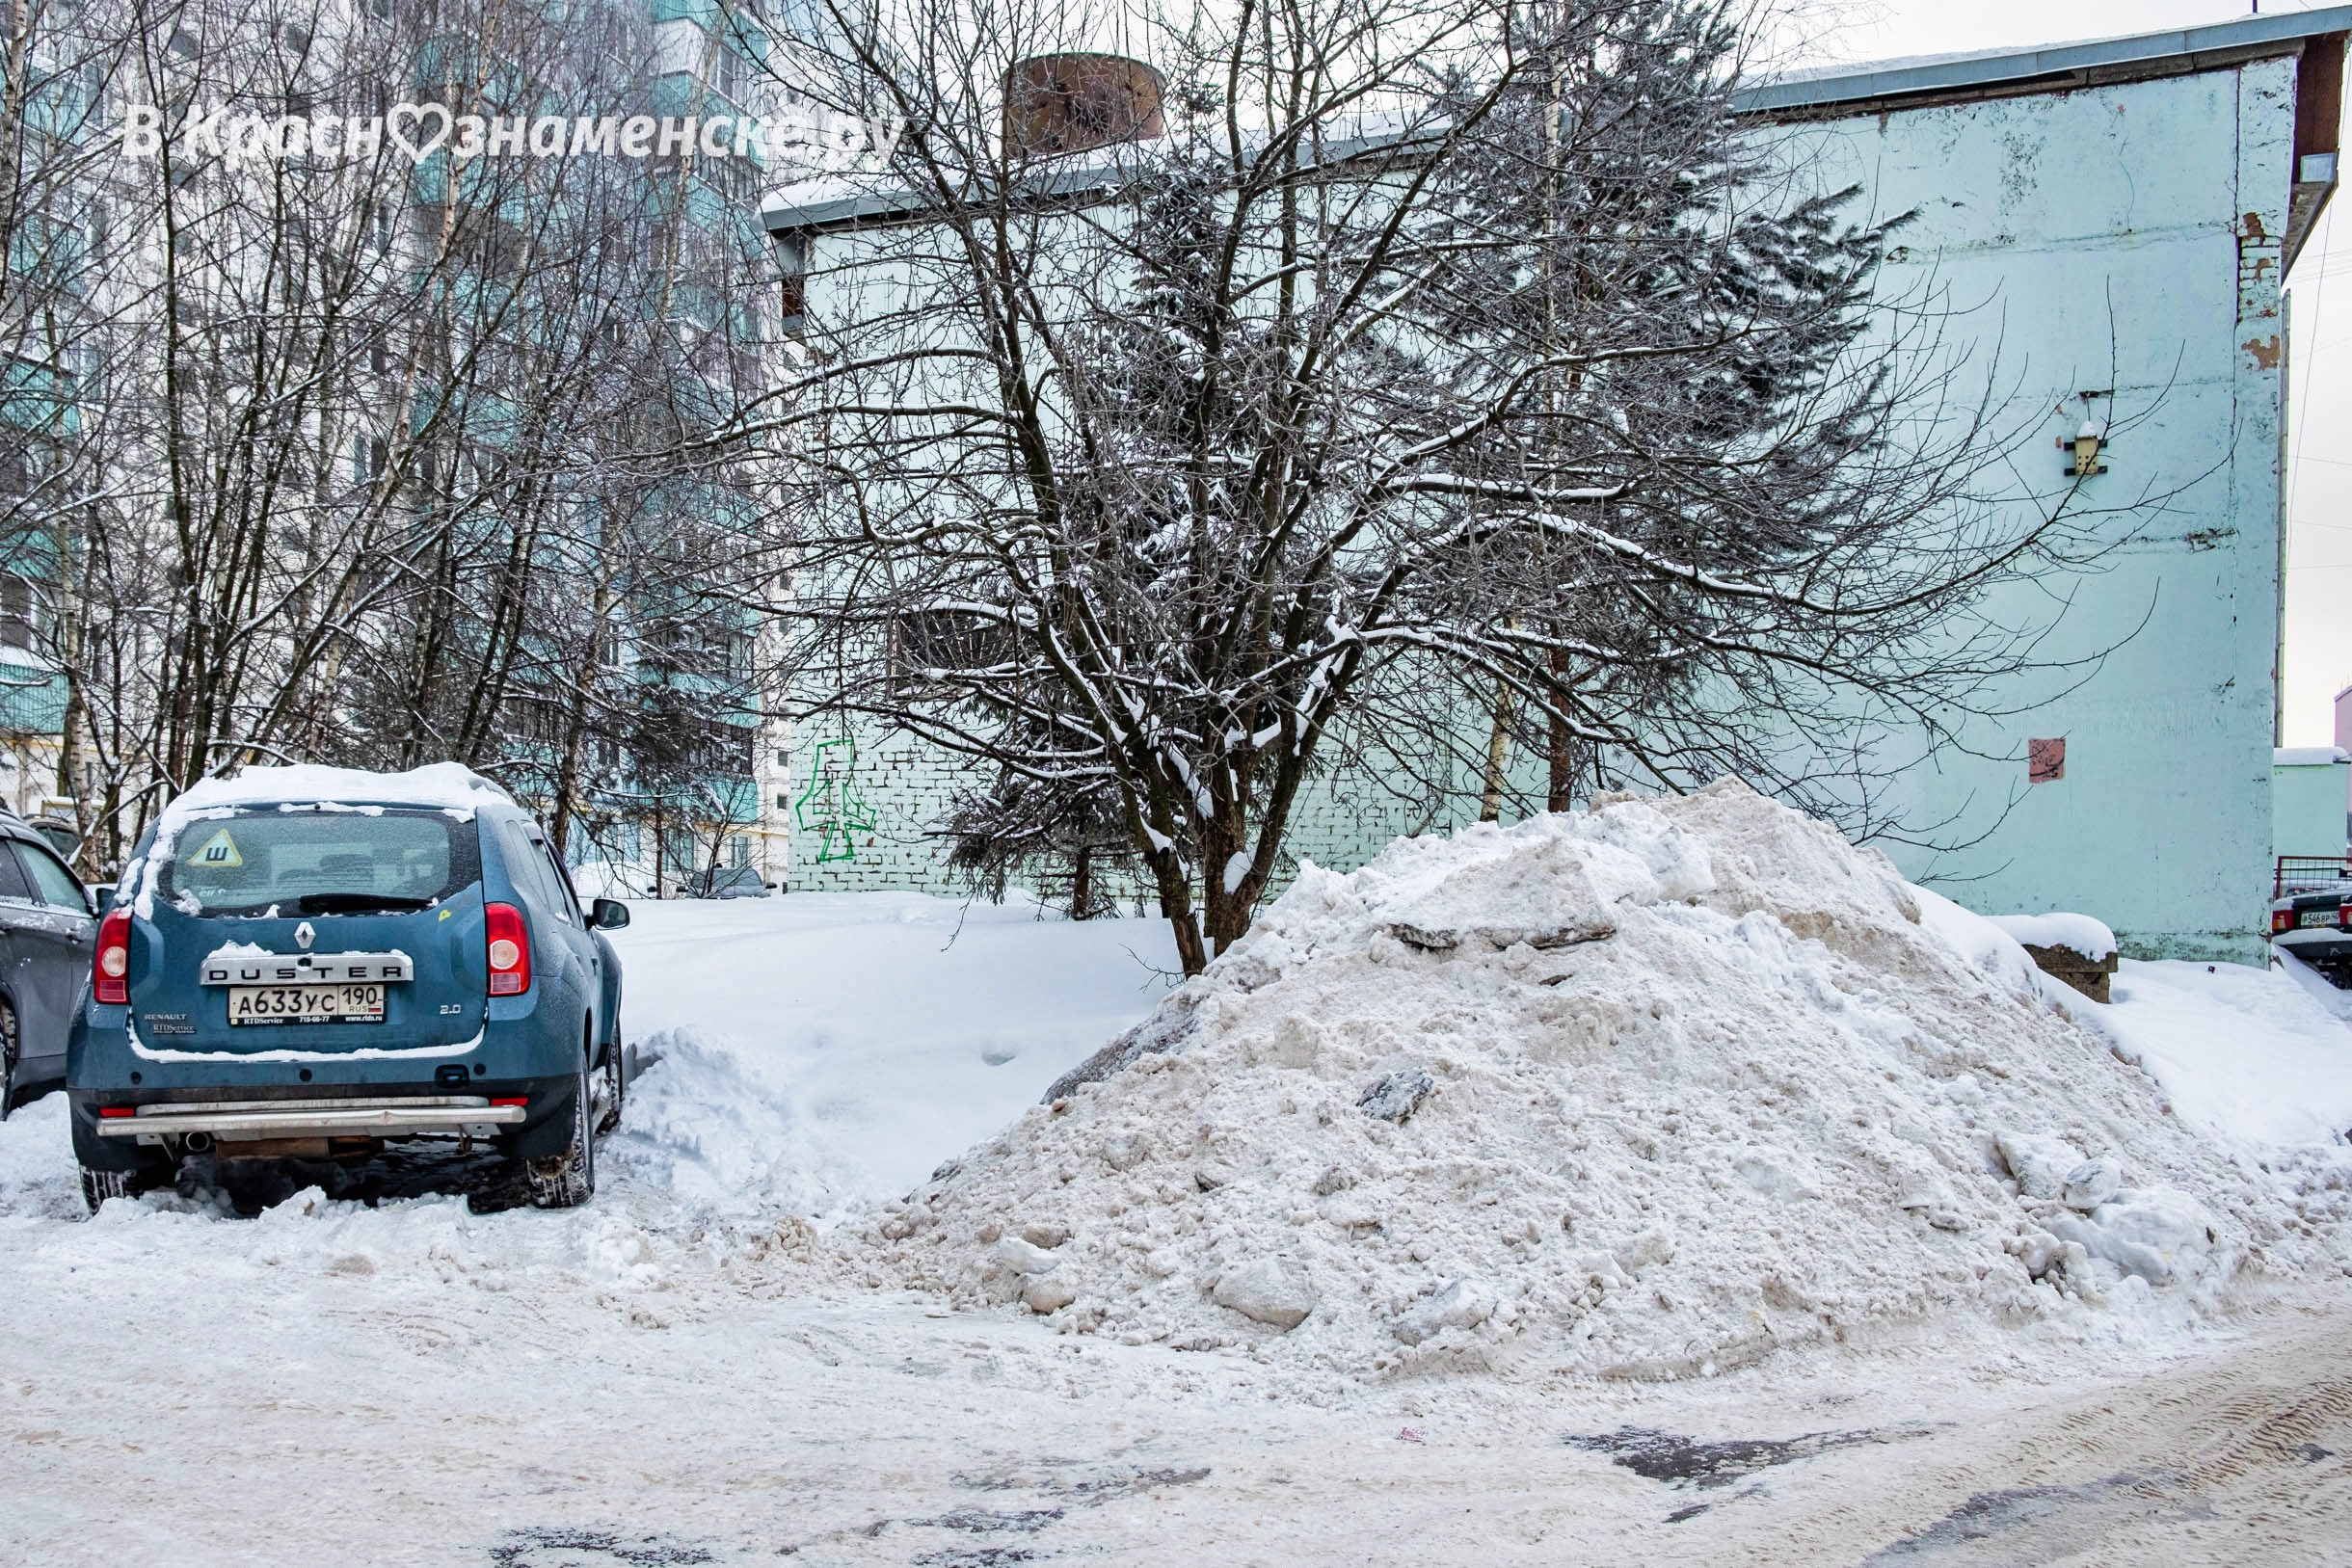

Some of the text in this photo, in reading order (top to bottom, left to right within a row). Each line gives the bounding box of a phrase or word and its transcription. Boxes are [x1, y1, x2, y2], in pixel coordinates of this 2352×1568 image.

[205, 847, 228, 862] Ш
[208, 966, 403, 981] DUSTER
[238, 987, 378, 1015] А633УС 190
[440, 1004, 462, 1015] 2.0
